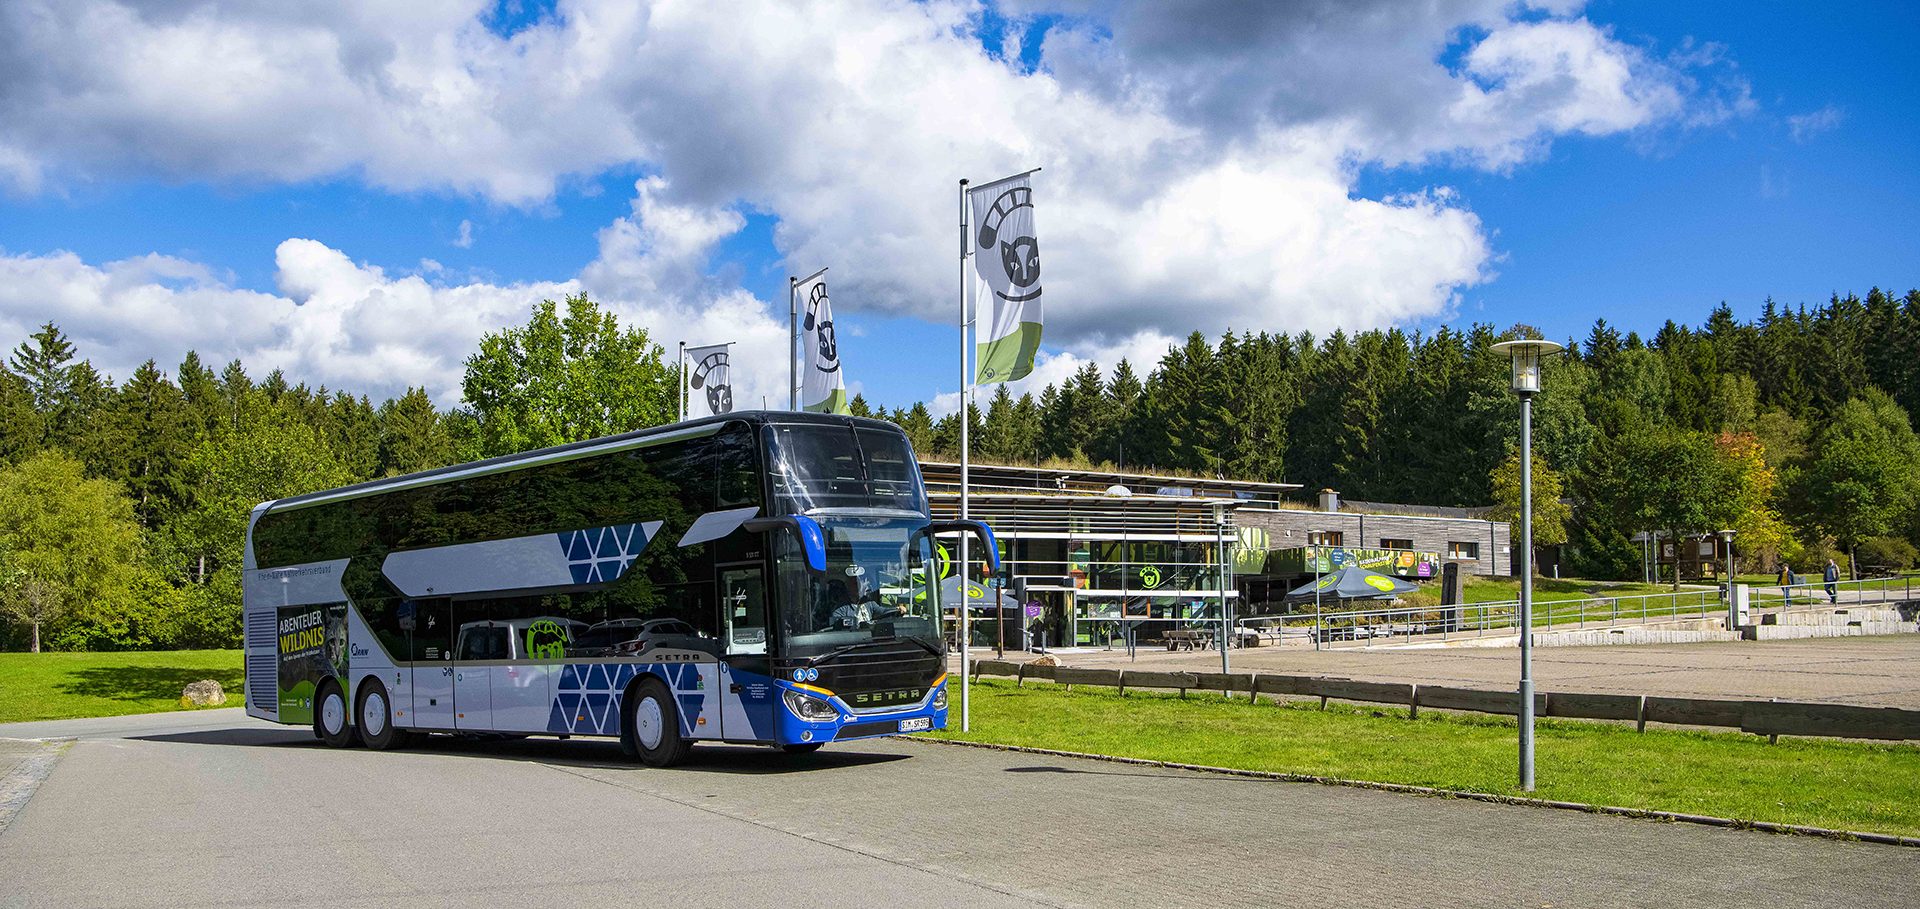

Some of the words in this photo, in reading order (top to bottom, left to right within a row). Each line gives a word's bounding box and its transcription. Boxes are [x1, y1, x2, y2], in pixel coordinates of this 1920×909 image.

[279, 610, 323, 634] ABENTEUER
[280, 626, 324, 654] WILDNIS
[655, 654, 701, 662] SETRA
[856, 689, 920, 703] SETRA
